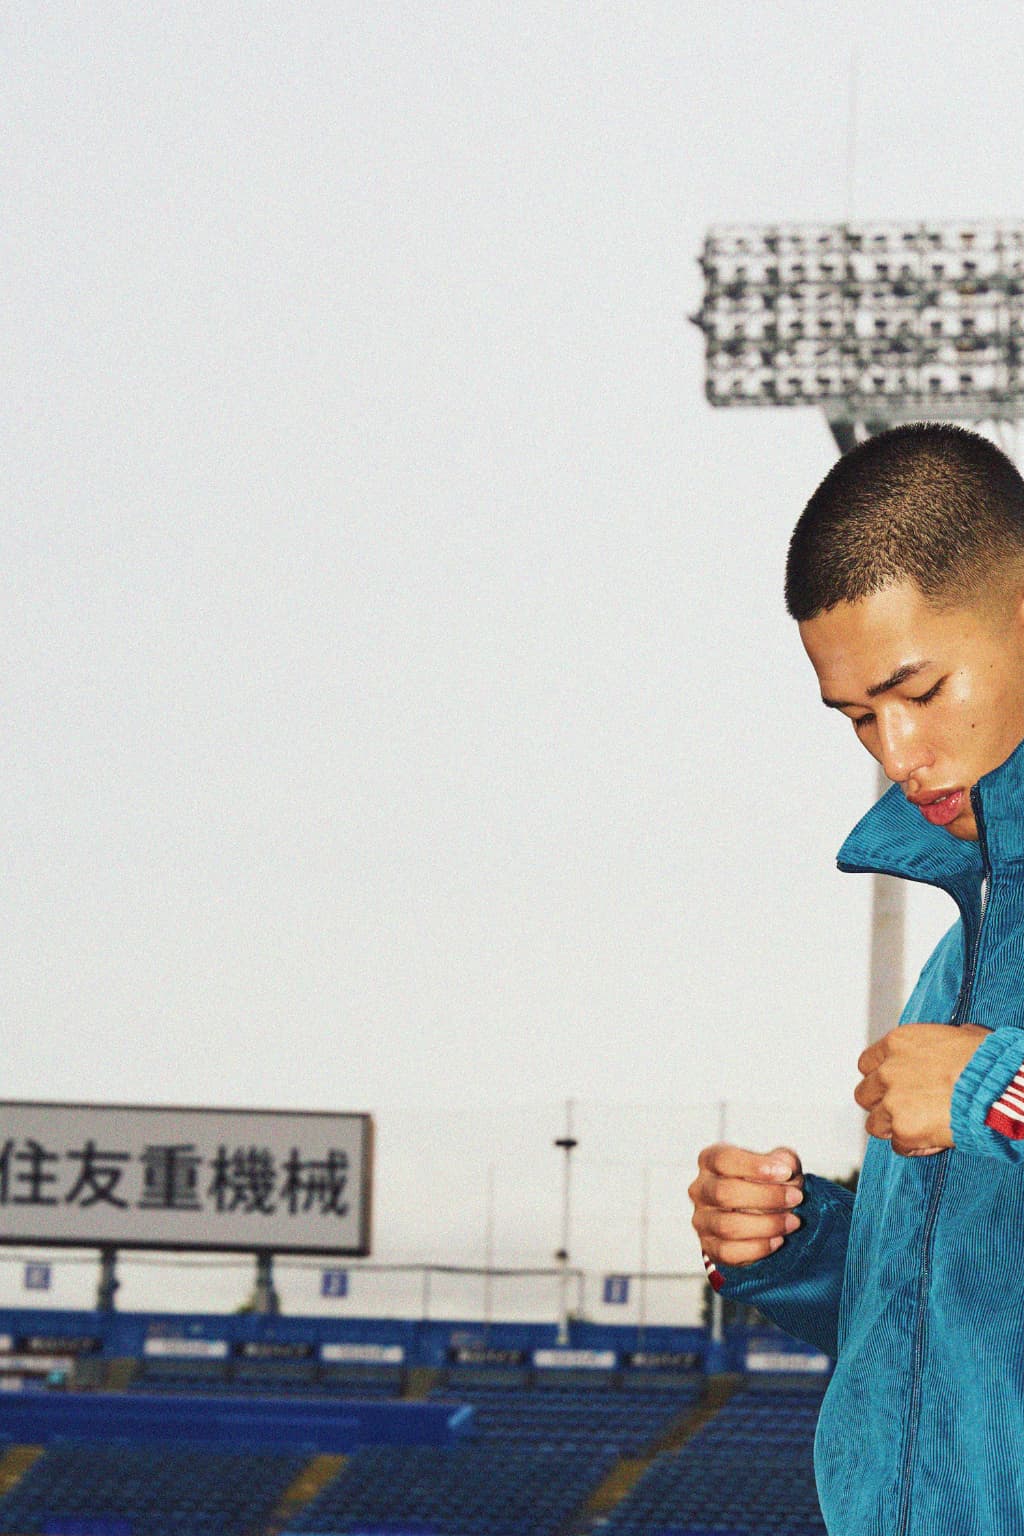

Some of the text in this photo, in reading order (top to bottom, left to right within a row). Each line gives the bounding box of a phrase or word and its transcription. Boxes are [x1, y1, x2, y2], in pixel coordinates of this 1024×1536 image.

[0, 1138, 349, 1217] 住友重機械
